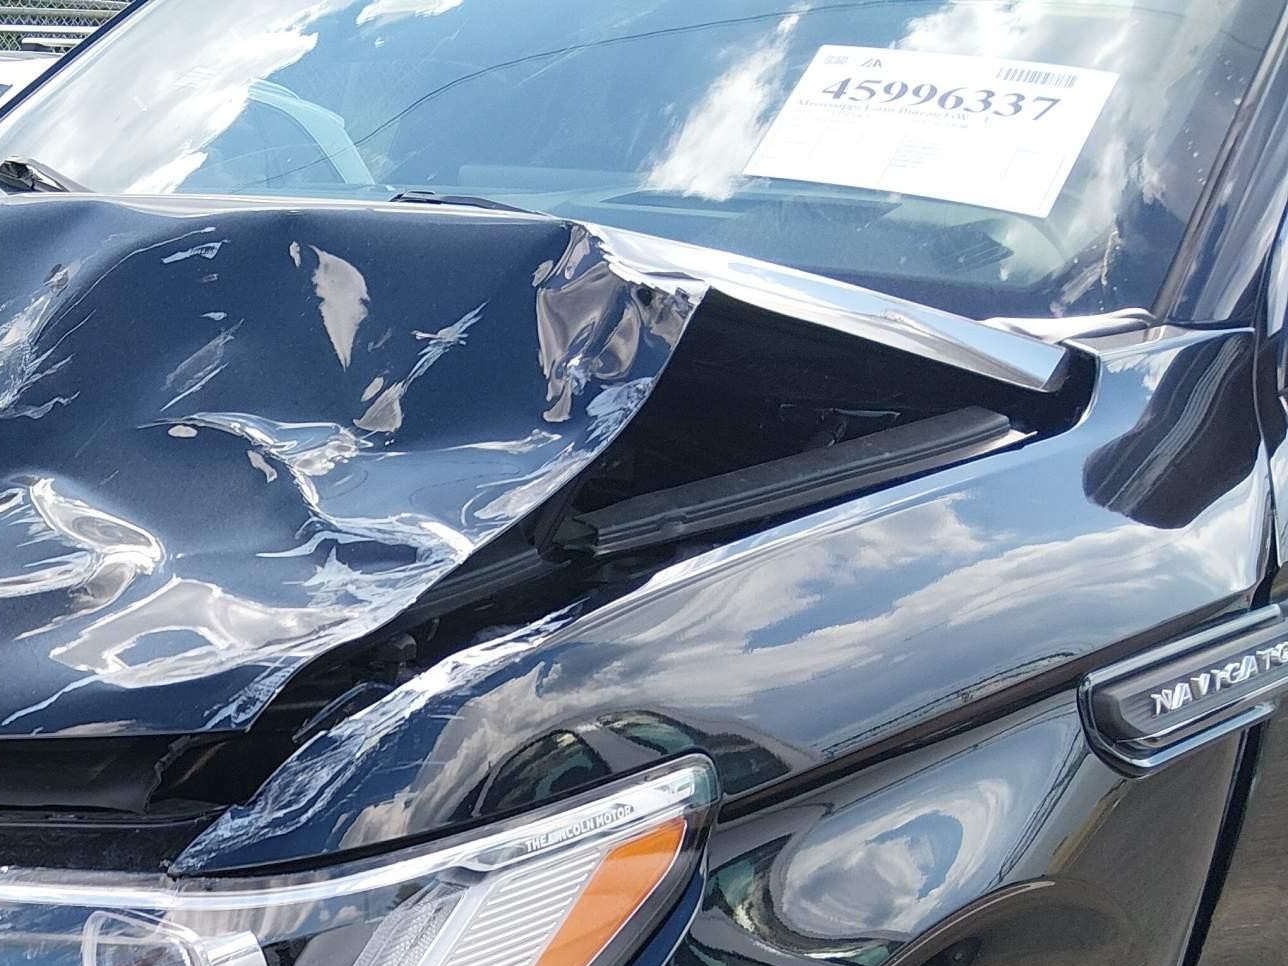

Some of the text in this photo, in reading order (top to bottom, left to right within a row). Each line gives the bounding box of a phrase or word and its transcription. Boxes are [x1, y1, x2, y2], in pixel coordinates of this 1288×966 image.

[821, 77, 1062, 121] 45996337
[525, 835, 549, 853] THE
[596, 805, 633, 828] MOTOR
